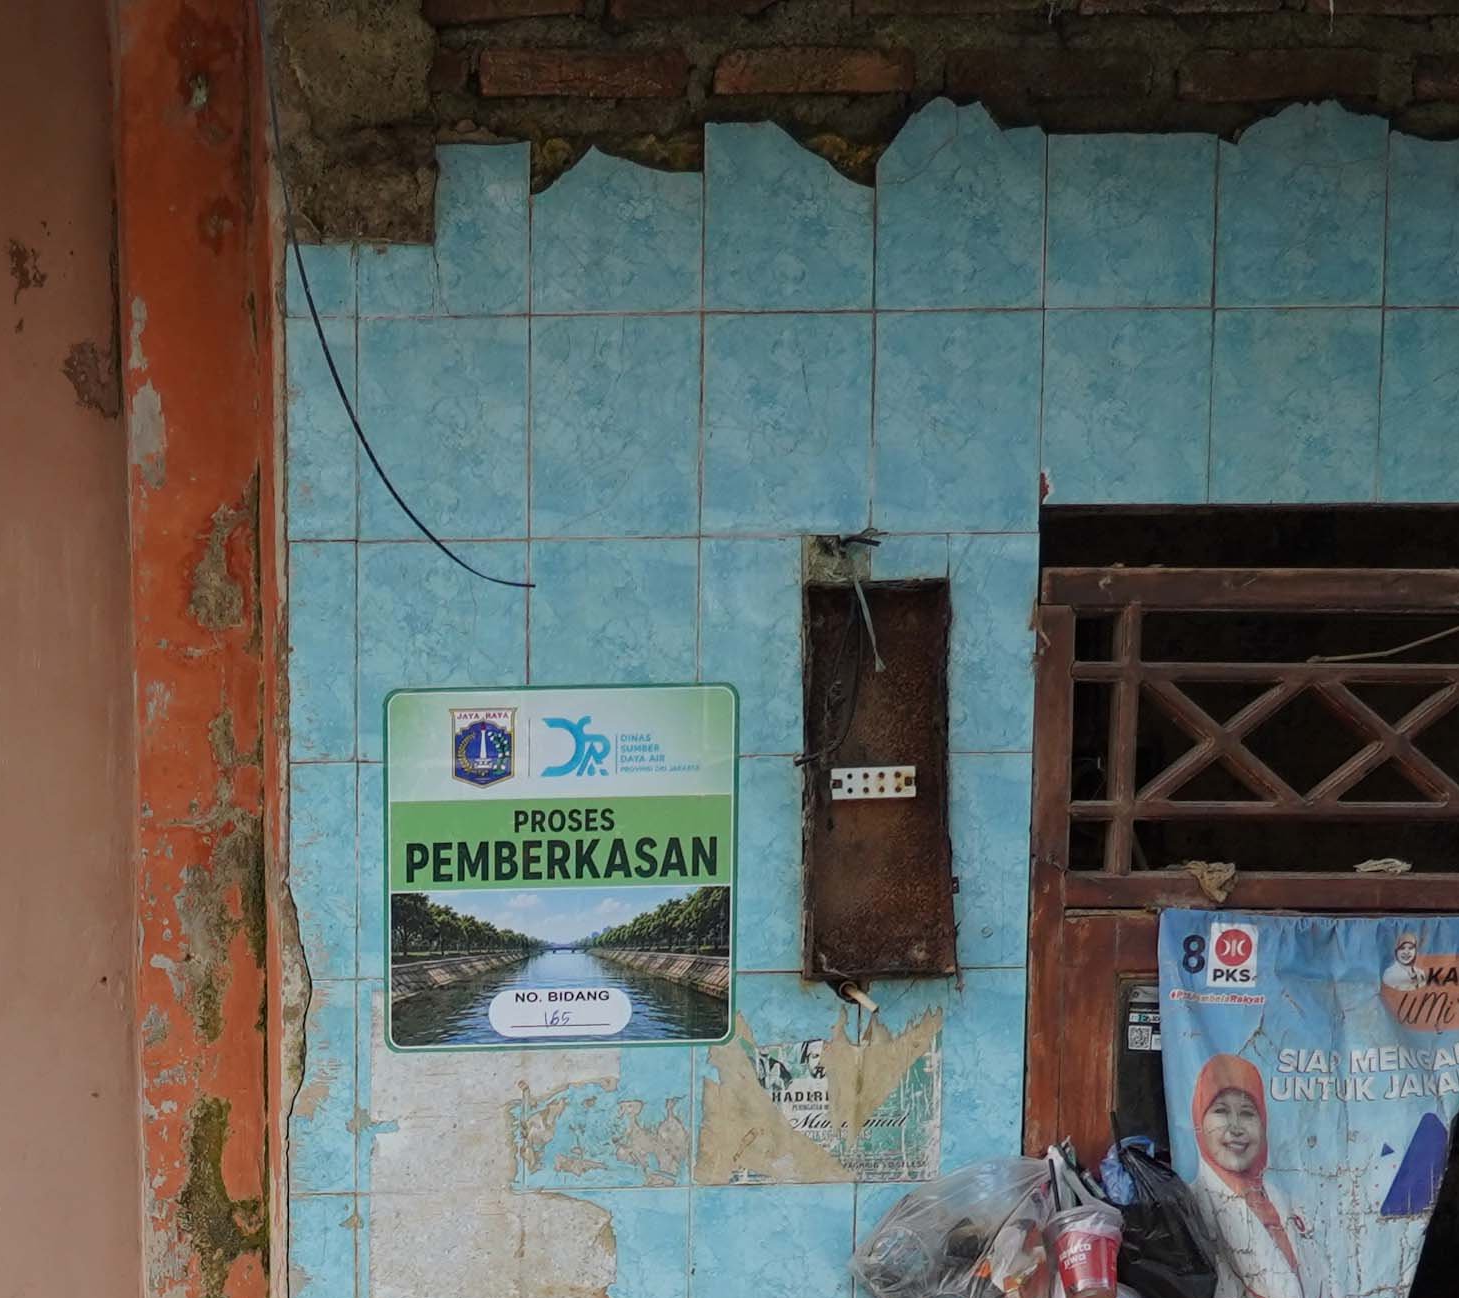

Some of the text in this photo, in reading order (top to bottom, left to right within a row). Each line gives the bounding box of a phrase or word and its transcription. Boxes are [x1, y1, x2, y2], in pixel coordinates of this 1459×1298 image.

[457, 712, 479, 720] JAYA
[620, 734, 651, 742] DINAS
[620, 744, 660, 752] SUMBER
[649, 754, 665, 762] AIR
[513, 808, 615, 833] PROSES
[405, 836, 718, 883] PEMBERKASAN
[1182, 934, 1206, 974] 8
[1212, 968, 1250, 982] PKS
[515, 990, 610, 1003] NO. BIDANG
[544, 1009, 573, 1027] 165
[1270, 1076, 1376, 1102] UNTUK
